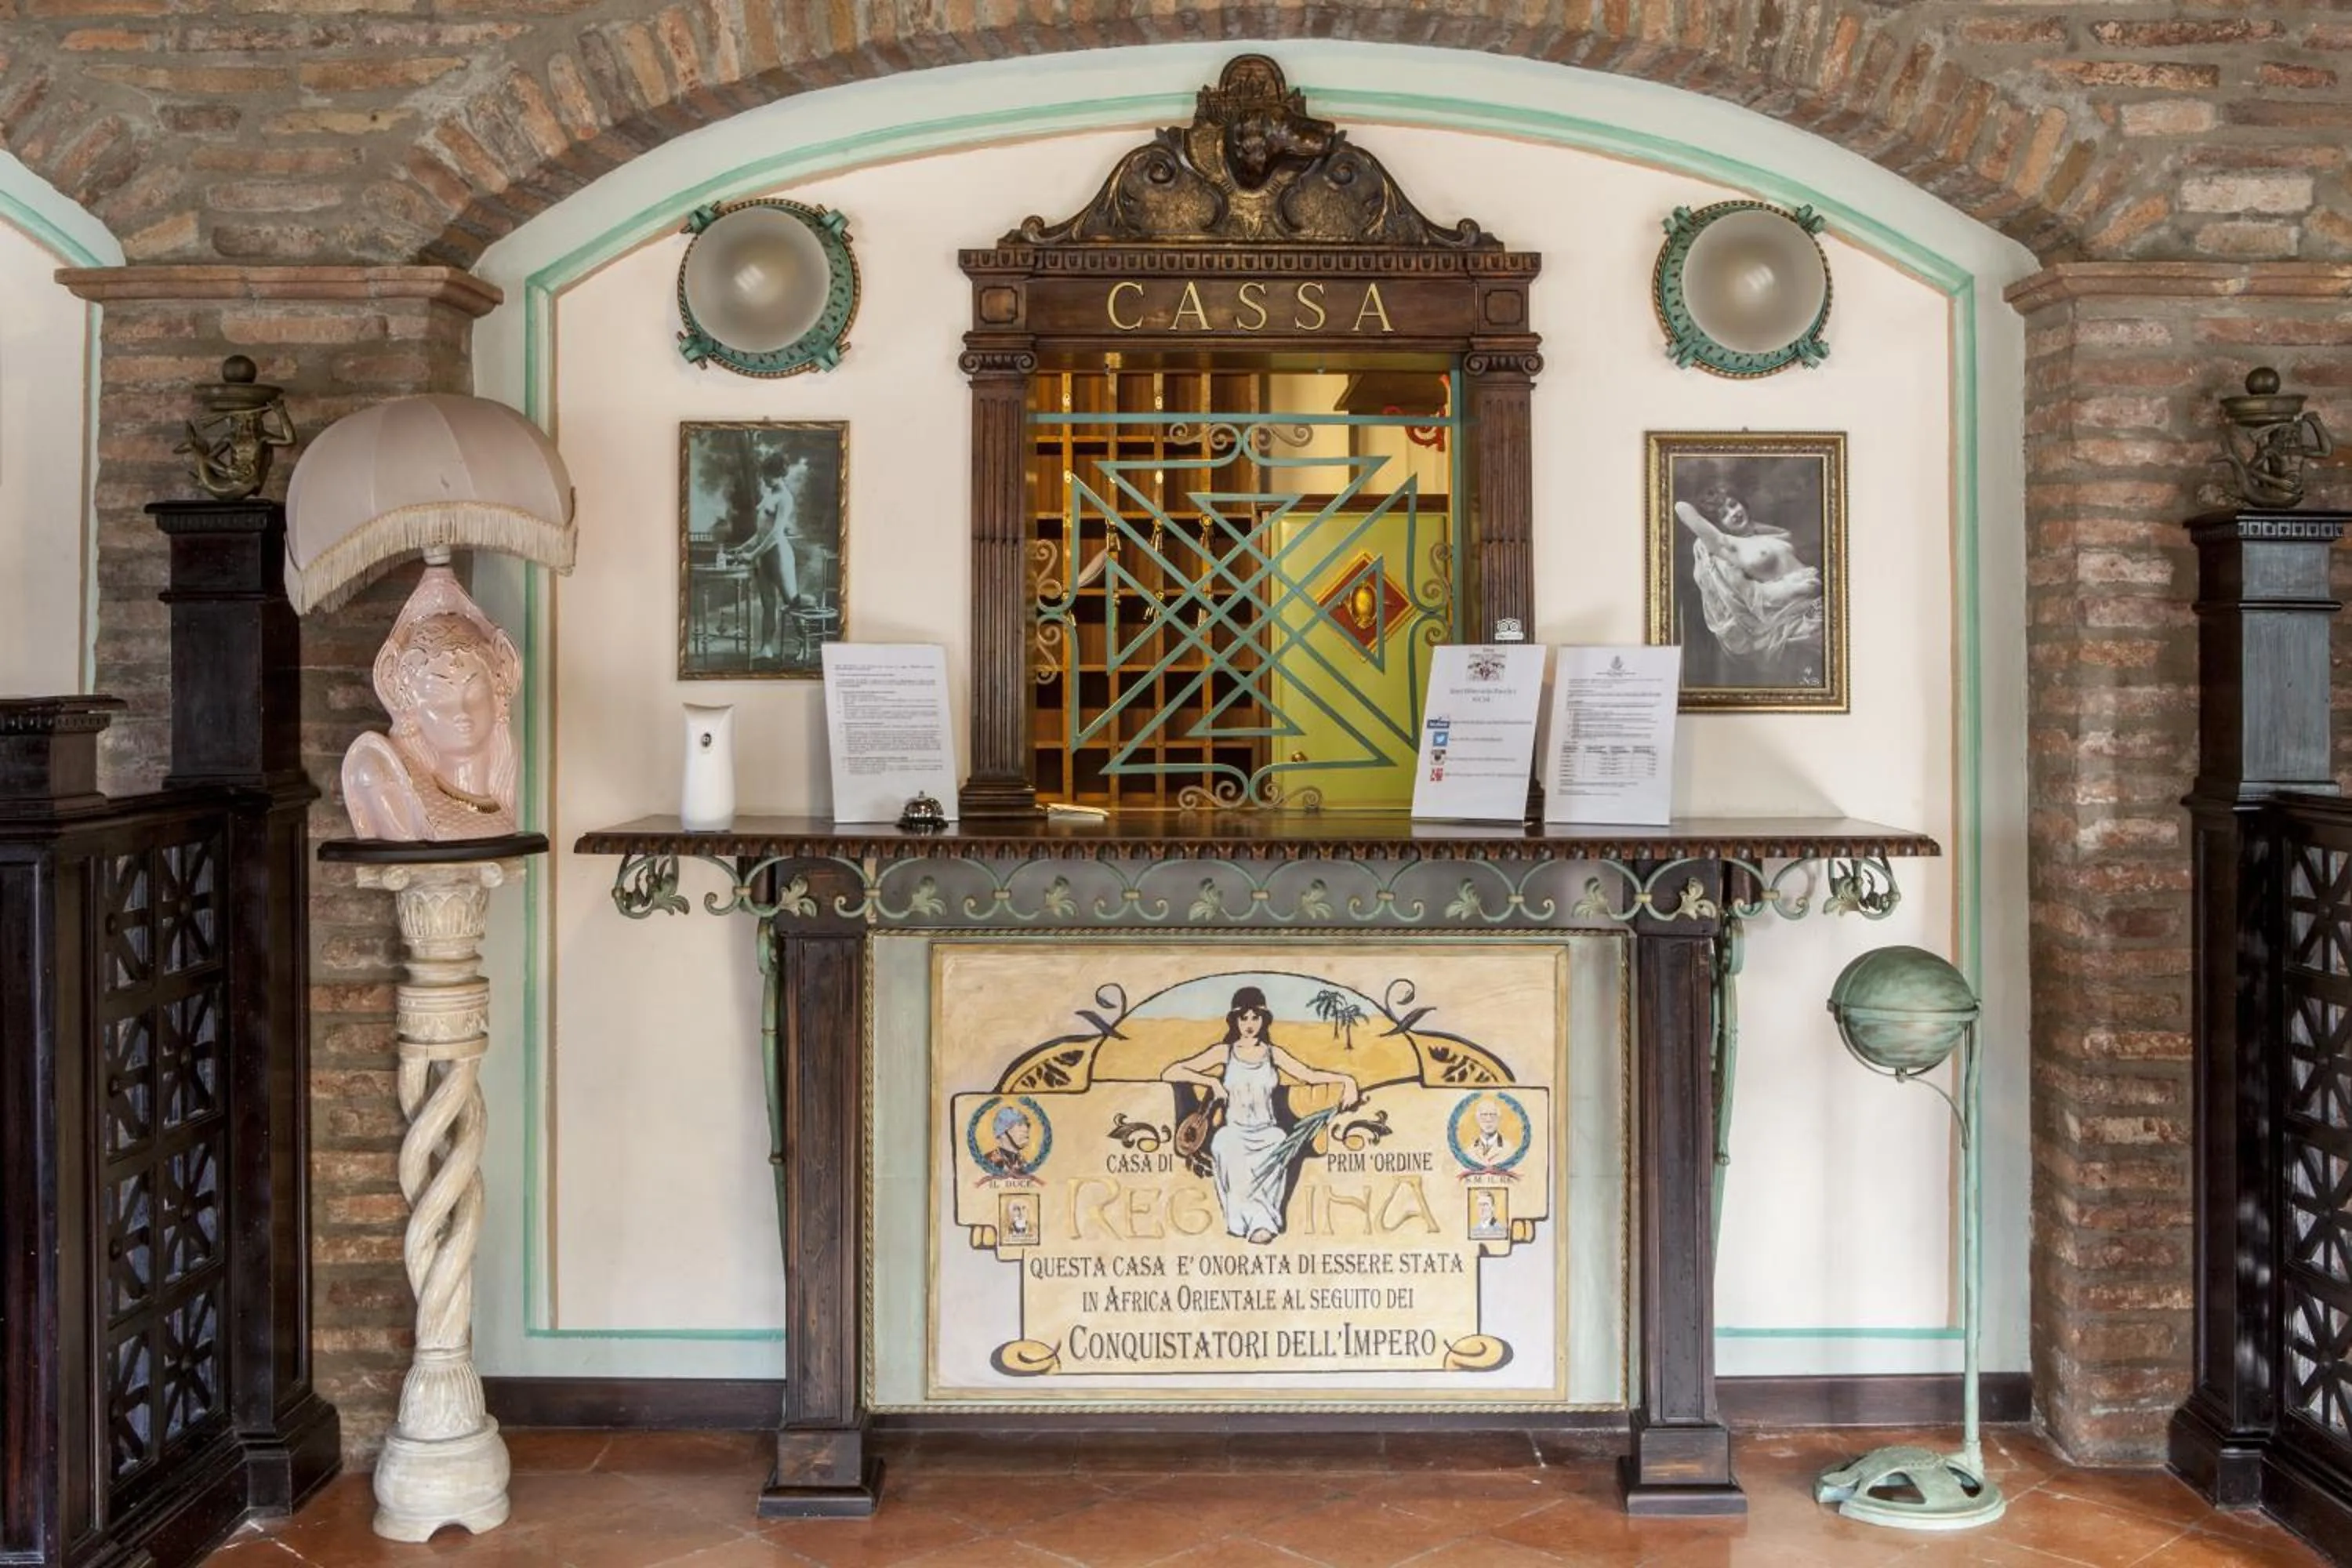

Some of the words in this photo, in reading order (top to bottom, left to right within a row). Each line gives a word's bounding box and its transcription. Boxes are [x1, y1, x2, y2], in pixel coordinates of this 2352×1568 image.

[1106, 281, 1394, 332] CASSA
[1106, 1153, 1152, 1174] CASA
[1158, 1153, 1173, 1173] DI
[1327, 1152, 1366, 1173] PRIM
[1029, 1256, 1106, 1279] QUESTA
[1112, 1255, 1167, 1277] CASA
[1199, 1254, 1291, 1276] ONORATA
[1298, 1254, 1316, 1275] DI
[1322, 1253, 1393, 1275] ESSERE
[1399, 1252, 1464, 1274] STATA
[1082, 1291, 1098, 1312] IN
[1105, 1286, 1173, 1313] AFRICA
[1178, 1284, 1277, 1313] ORIENTALE
[1282, 1289, 1305, 1311] AL
[1309, 1287, 1382, 1310] SEGUITO
[1386, 1287, 1414, 1309] DEI
[1069, 1324, 1269, 1361] CONQUISTATORI
[1276, 1322, 1436, 1359] DELL'IMPERO
